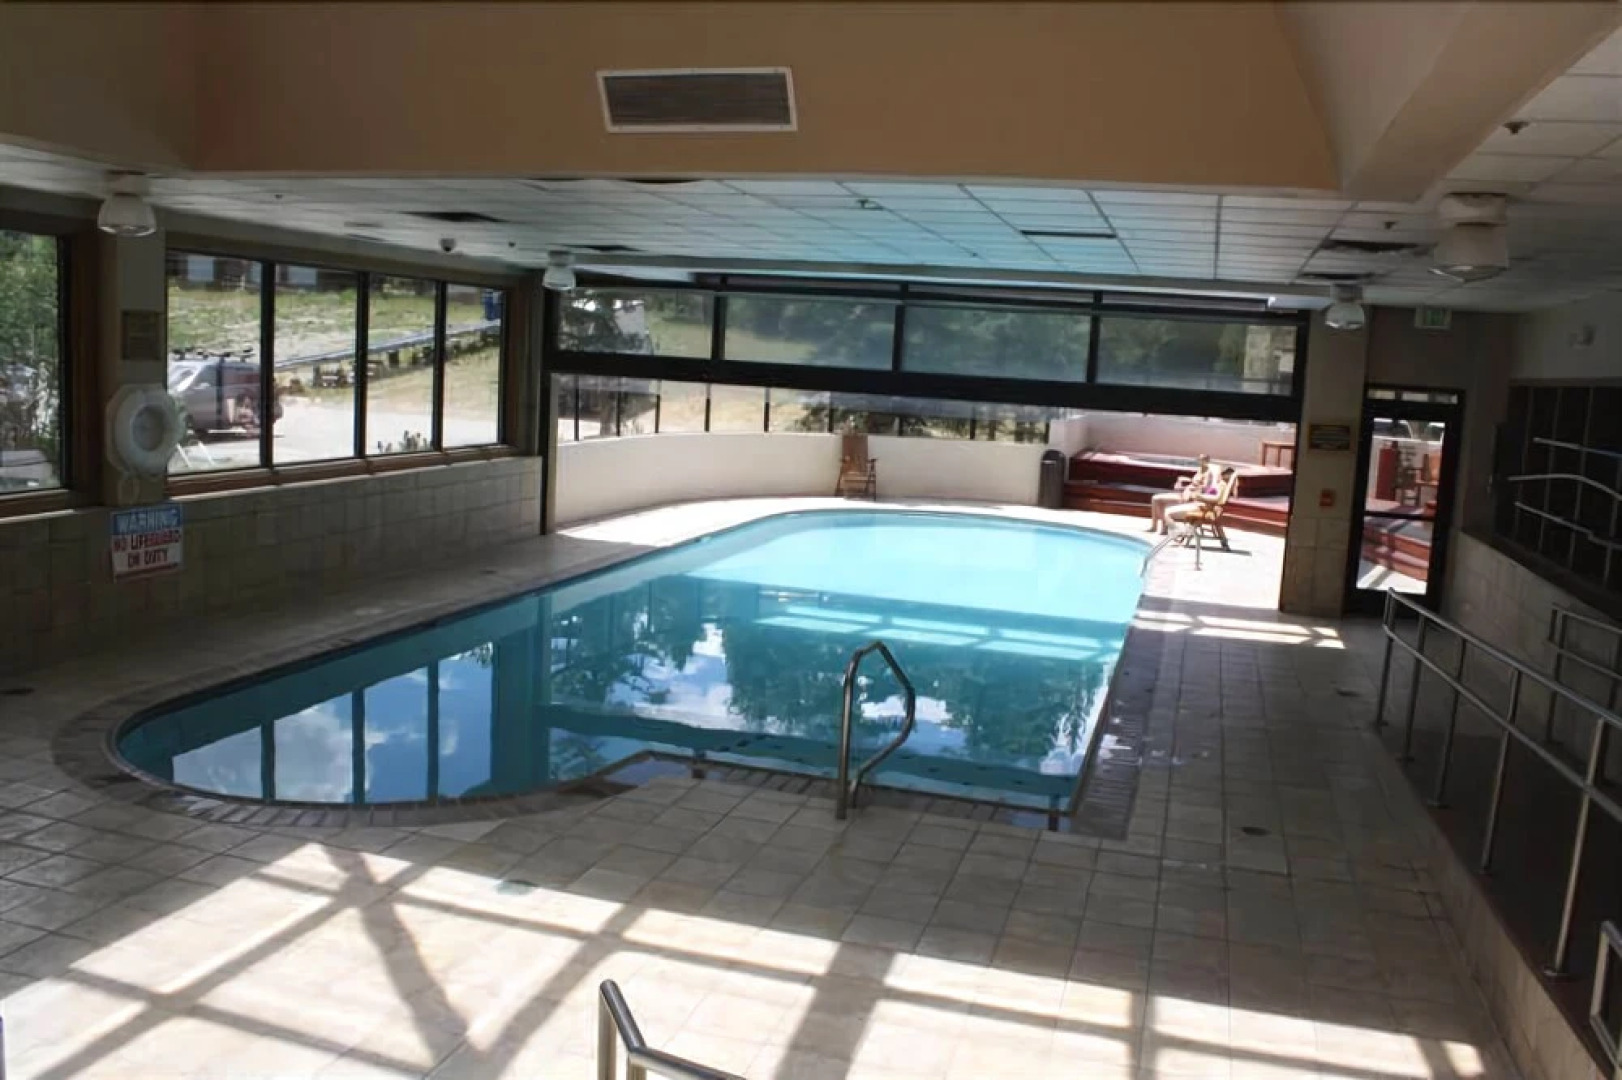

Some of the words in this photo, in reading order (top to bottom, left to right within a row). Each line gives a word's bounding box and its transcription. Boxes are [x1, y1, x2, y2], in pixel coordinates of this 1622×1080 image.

[114, 537, 127, 552] NO
[128, 552, 140, 568] ON
[144, 548, 168, 565] DUTY
